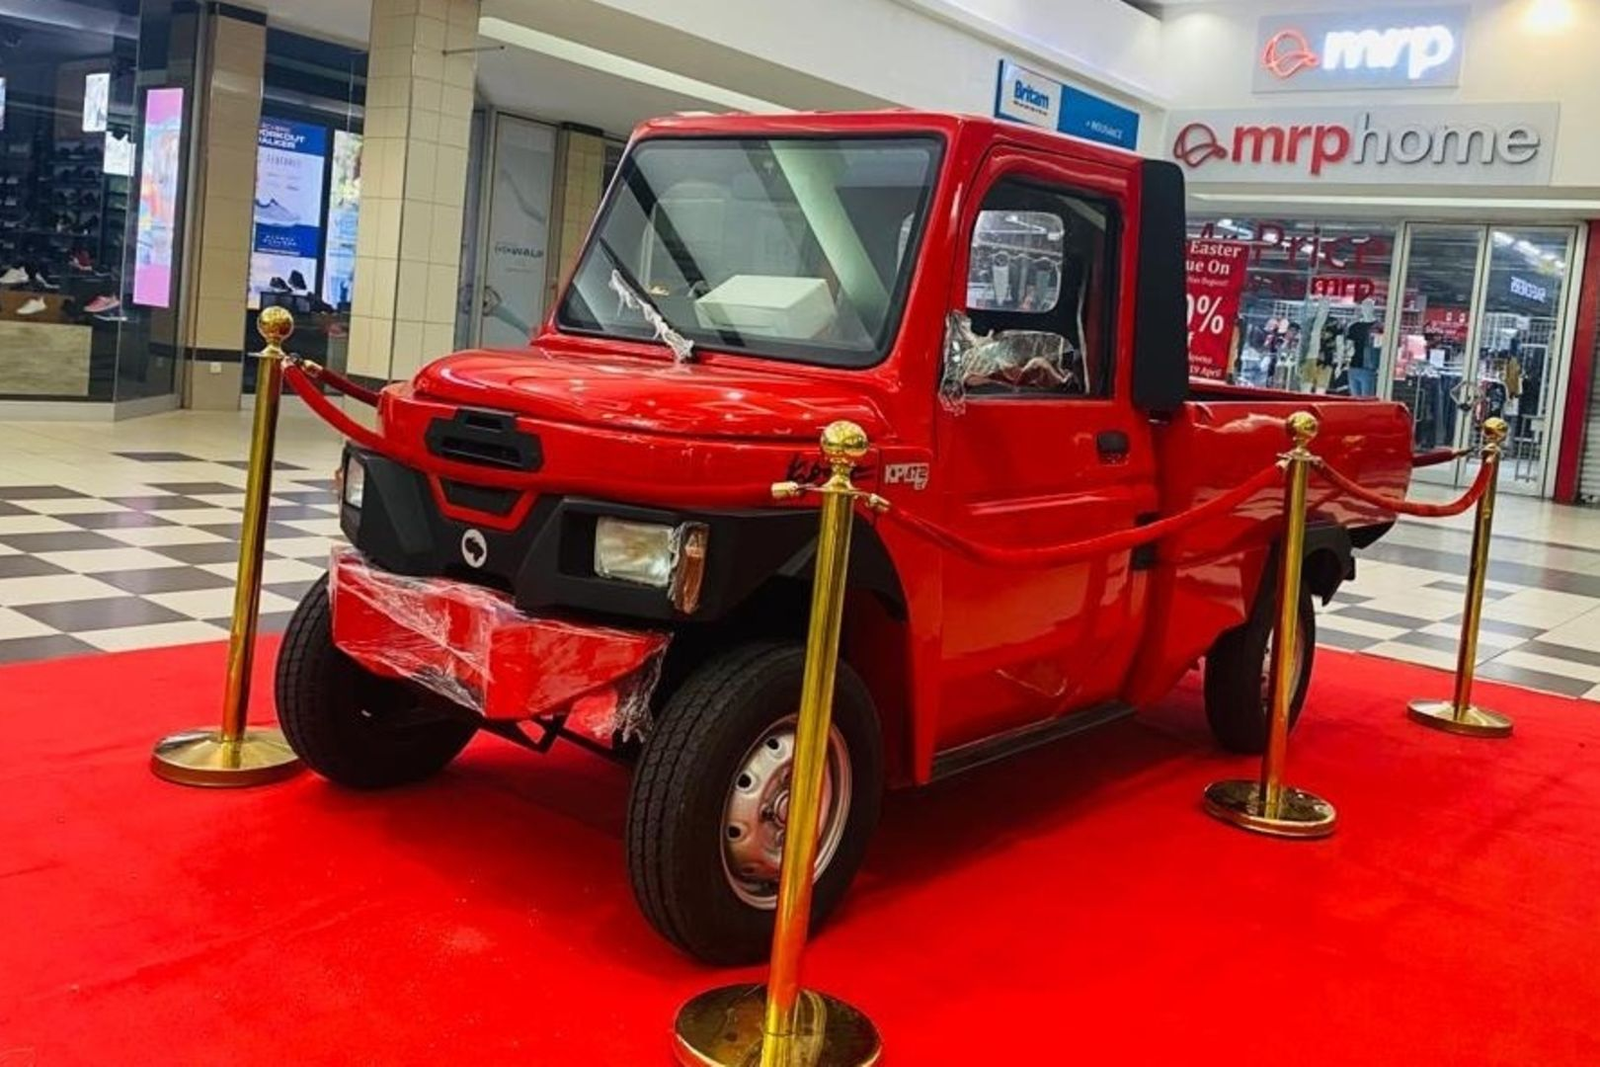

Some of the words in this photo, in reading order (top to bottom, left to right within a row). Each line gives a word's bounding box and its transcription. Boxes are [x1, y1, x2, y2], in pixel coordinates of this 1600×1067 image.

[1322, 24, 1454, 79] mrp
[1014, 80, 1049, 109] Britam
[1190, 240, 1242, 258] Easter
[1208, 259, 1230, 275] On
